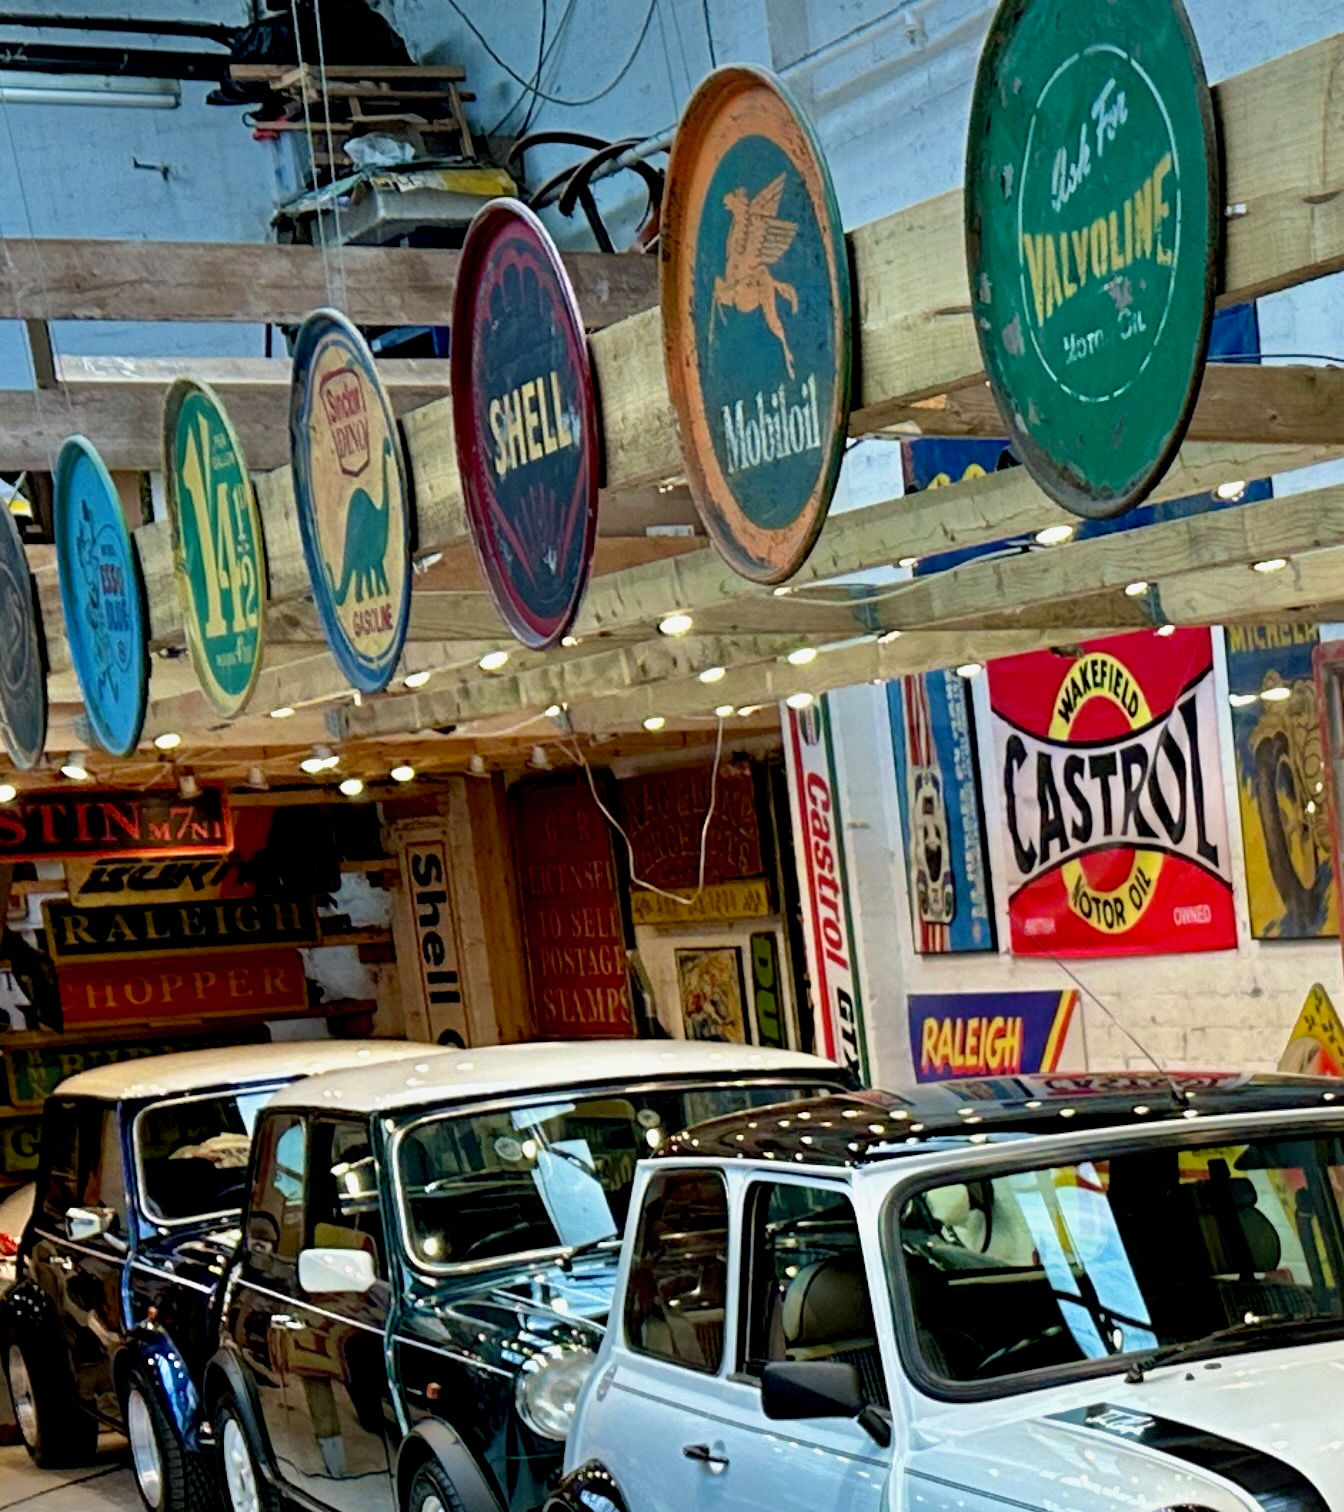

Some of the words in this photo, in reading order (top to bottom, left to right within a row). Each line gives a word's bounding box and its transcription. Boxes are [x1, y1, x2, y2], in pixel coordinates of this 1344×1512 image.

[1051, 122, 1091, 213] Ask
[1091, 77, 1128, 158] For
[1023, 151, 1173, 328] VALVOLINE
[336, 419, 367, 458] DINO
[488, 371, 573, 475] SHELL
[722, 372, 822, 473] Mobiloil
[352, 603, 394, 638] GASOLINE
[1059, 659, 1140, 725] WAKEFIELD
[1004, 694, 1220, 874] CASTROL
[806, 771, 849, 970] Castrol
[1073, 878, 1126, 928] MOTOR
[1130, 866, 1153, 911] OIL
[60, 900, 304, 946] RALEIGH
[412, 853, 461, 1004] Shell
[63, 966, 289, 1012] CHOPPER
[541, 943, 625, 978] POSTAGE
[543, 985, 631, 1025] STAMPS
[922, 1016, 1022, 1073] RALEIGH
